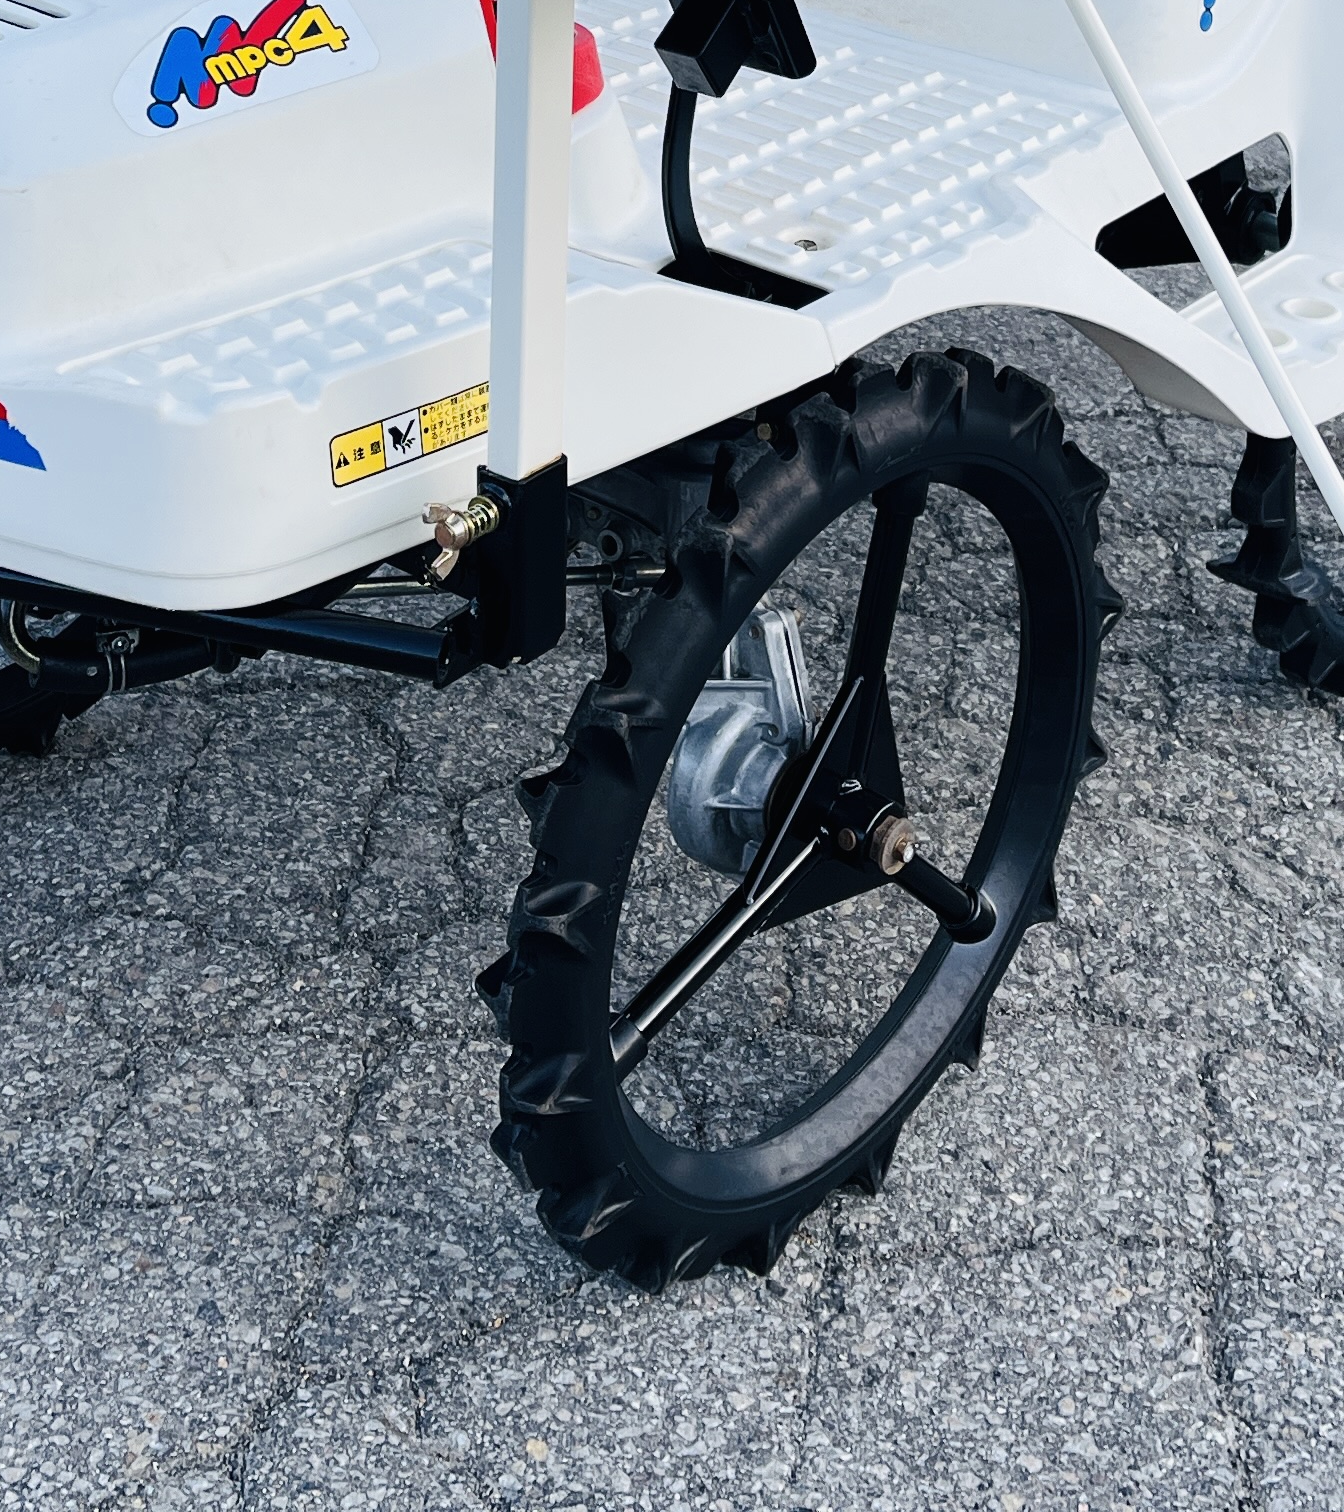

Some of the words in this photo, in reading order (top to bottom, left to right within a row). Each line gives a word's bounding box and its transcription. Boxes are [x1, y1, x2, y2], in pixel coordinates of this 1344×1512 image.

[430, 403, 490, 432] はずしたままで運
[353, 440, 382, 462] 注意
